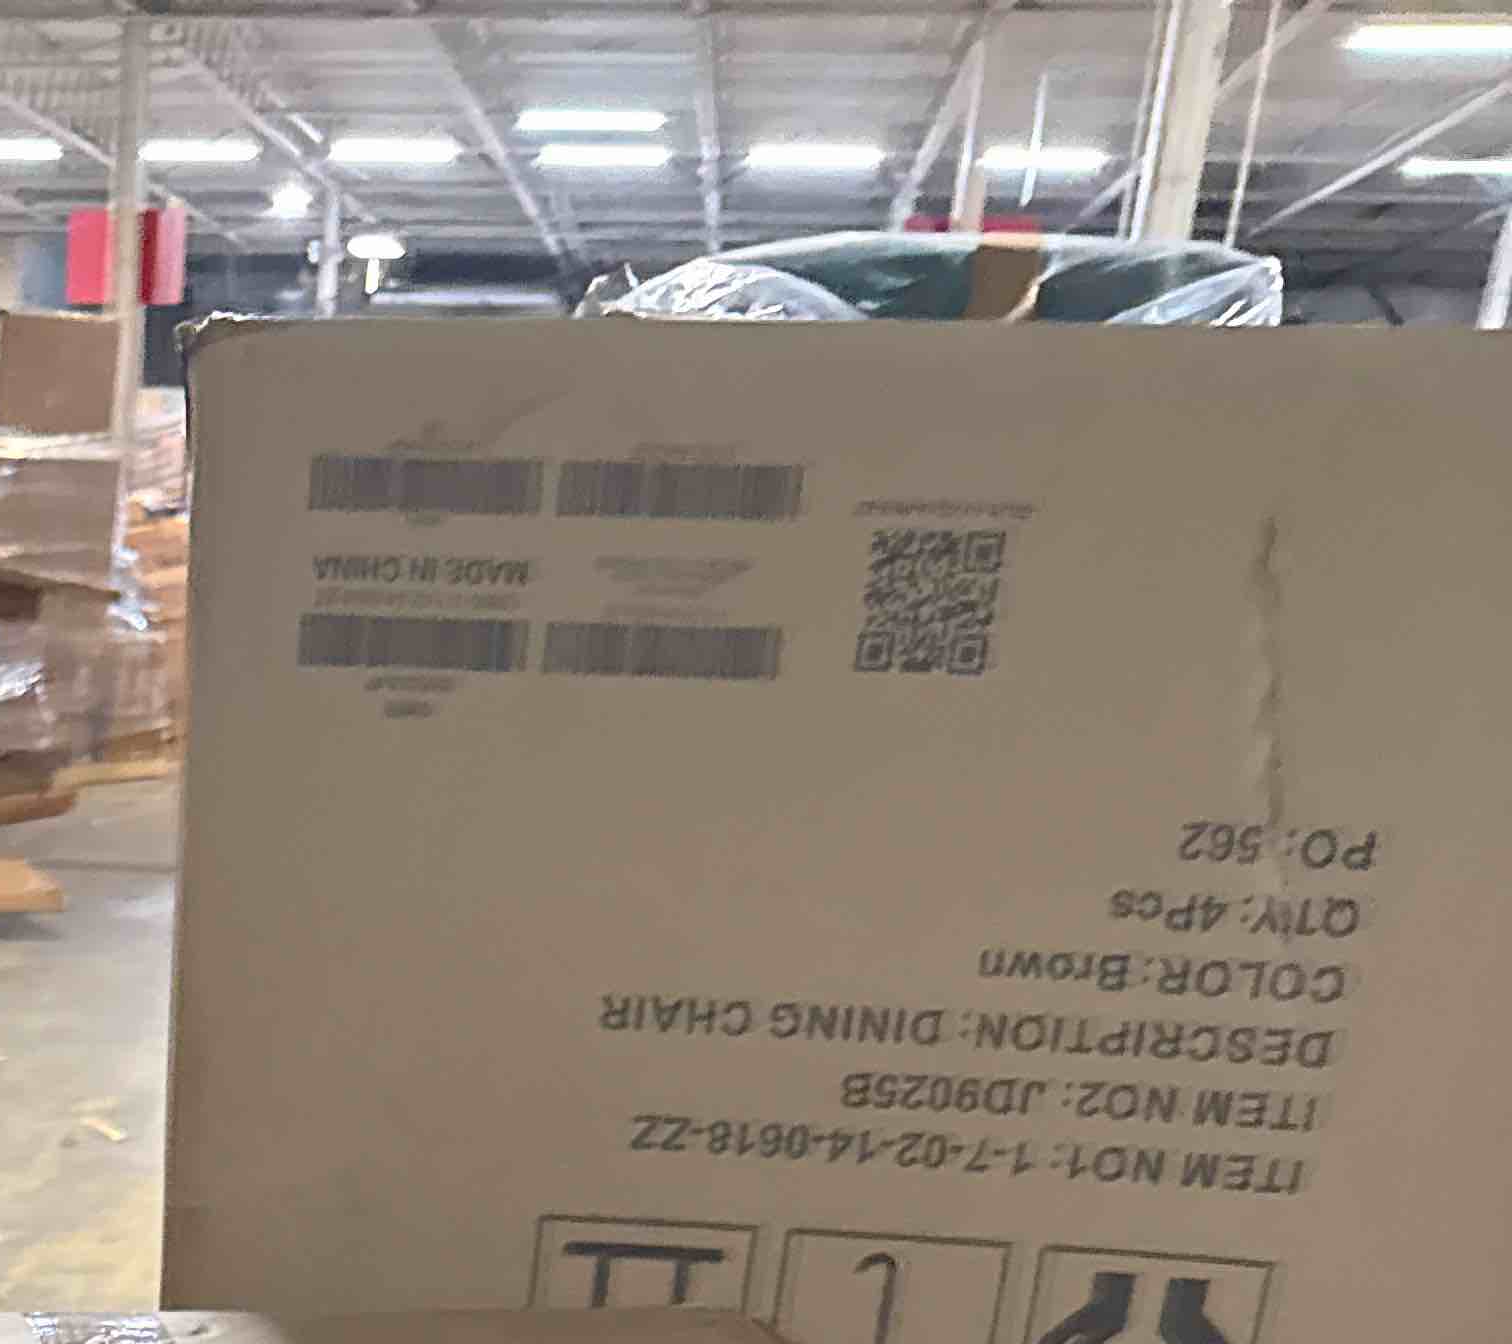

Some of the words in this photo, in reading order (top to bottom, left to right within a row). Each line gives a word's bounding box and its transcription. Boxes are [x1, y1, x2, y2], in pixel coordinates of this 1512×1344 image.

[312, 555, 400, 583] CHINA
[408, 556, 436, 583] IN
[445, 556, 528, 585] MADE
[1178, 821, 1262, 863] 562
[1285, 827, 1377, 870] PO:
[1109, 888, 1226, 931] 4Pcs
[1239, 892, 1360, 937] QTY:
[978, 947, 1128, 992] Brown
[598, 994, 750, 1036] CHAIR
[768, 1000, 944, 1046] DINING
[959, 1009, 1335, 1068] DESCRIPTION:
[840, 1072, 1045, 1115] JD9025B
[1061, 1079, 1176, 1120] NO2:
[1194, 1088, 1319, 1131] ITEM
[1048, 1142, 1164, 1185] NO1:
[1181, 1150, 1303, 1195] ITEM
